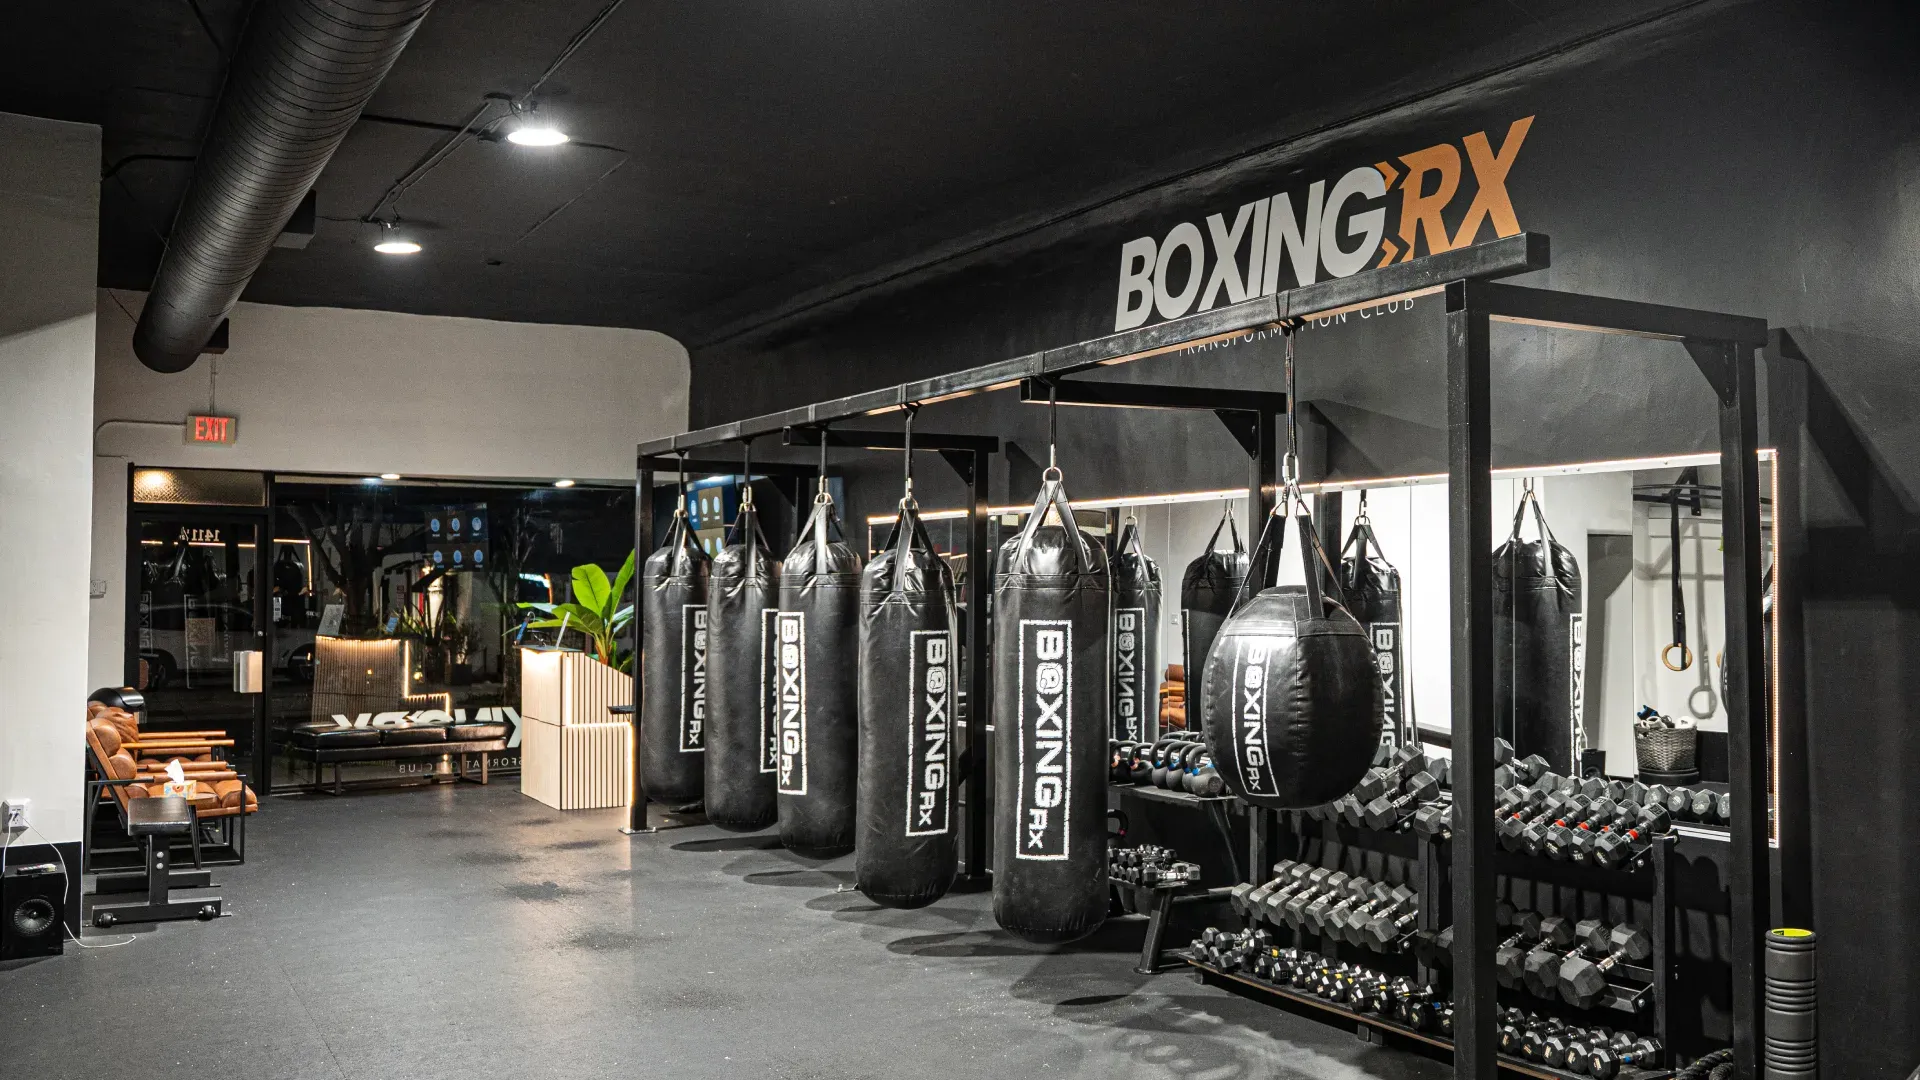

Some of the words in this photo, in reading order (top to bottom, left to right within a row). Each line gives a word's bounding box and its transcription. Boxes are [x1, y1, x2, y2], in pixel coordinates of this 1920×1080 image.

[1115, 166, 1387, 332] BOXING
[1397, 115, 1536, 262] RX
[195, 416, 229, 442] EXIT
[782, 619, 800, 755] BOXING
[925, 638, 946, 791] BOXING
[1034, 629, 1064, 809] BOXING
